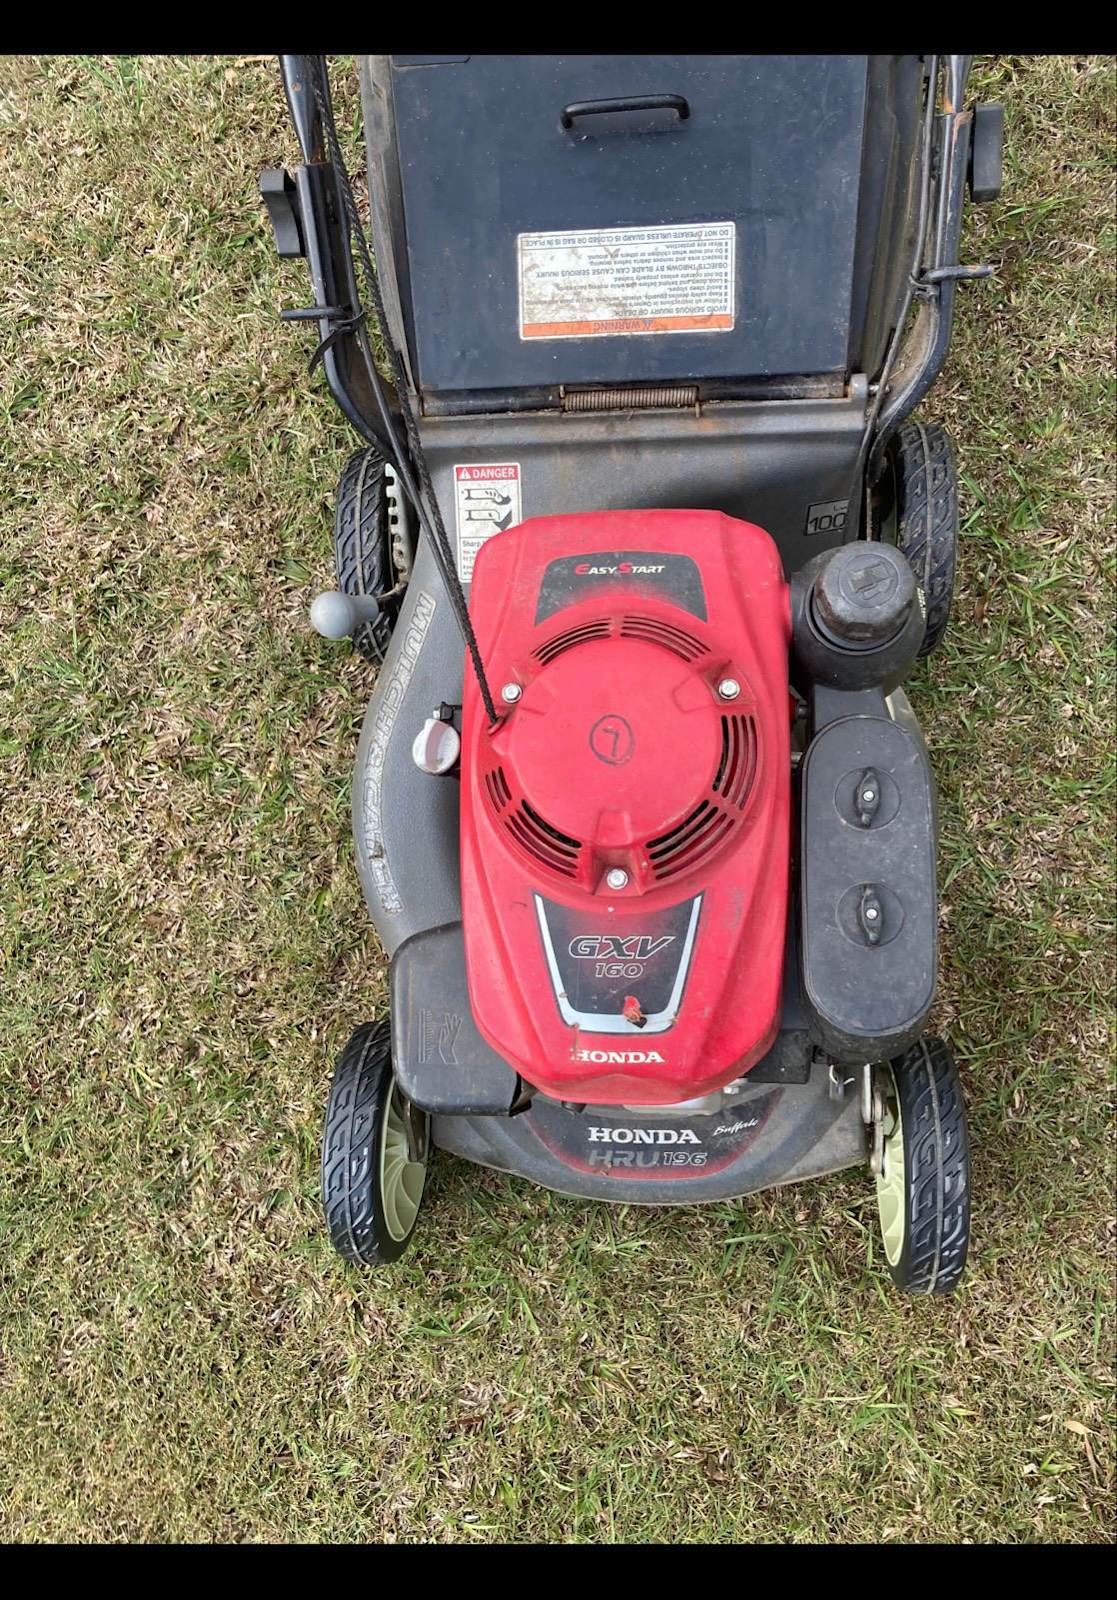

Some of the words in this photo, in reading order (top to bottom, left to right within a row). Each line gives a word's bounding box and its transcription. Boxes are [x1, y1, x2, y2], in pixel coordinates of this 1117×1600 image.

[646, 232, 672, 240] UNLESS
[672, 230, 703, 238] OPERATE
[718, 228, 729, 236] DO
[562, 237, 576, 245] BAG
[588, 235, 613, 243] CLOSED
[622, 233, 645, 241] GUARD
[631, 265, 653, 273] BLADE
[666, 263, 696, 271] THROWN
[697, 261, 728, 269] OBJECTS
[592, 267, 614, 275] CAUSE
[593, 320, 640, 330] WARNING
[473, 468, 515, 479] DANGER
[809, 512, 846, 532] 100
[375, 593, 435, 739] MULCH
[568, 935, 677, 959] GXV
[595, 962, 644, 979] 160
[570, 1049, 665, 1064] HONDA
[712, 1117, 759, 1137] Buffalo
[587, 1126, 702, 1145] HONDA
[663, 1151, 708, 1166] 196
